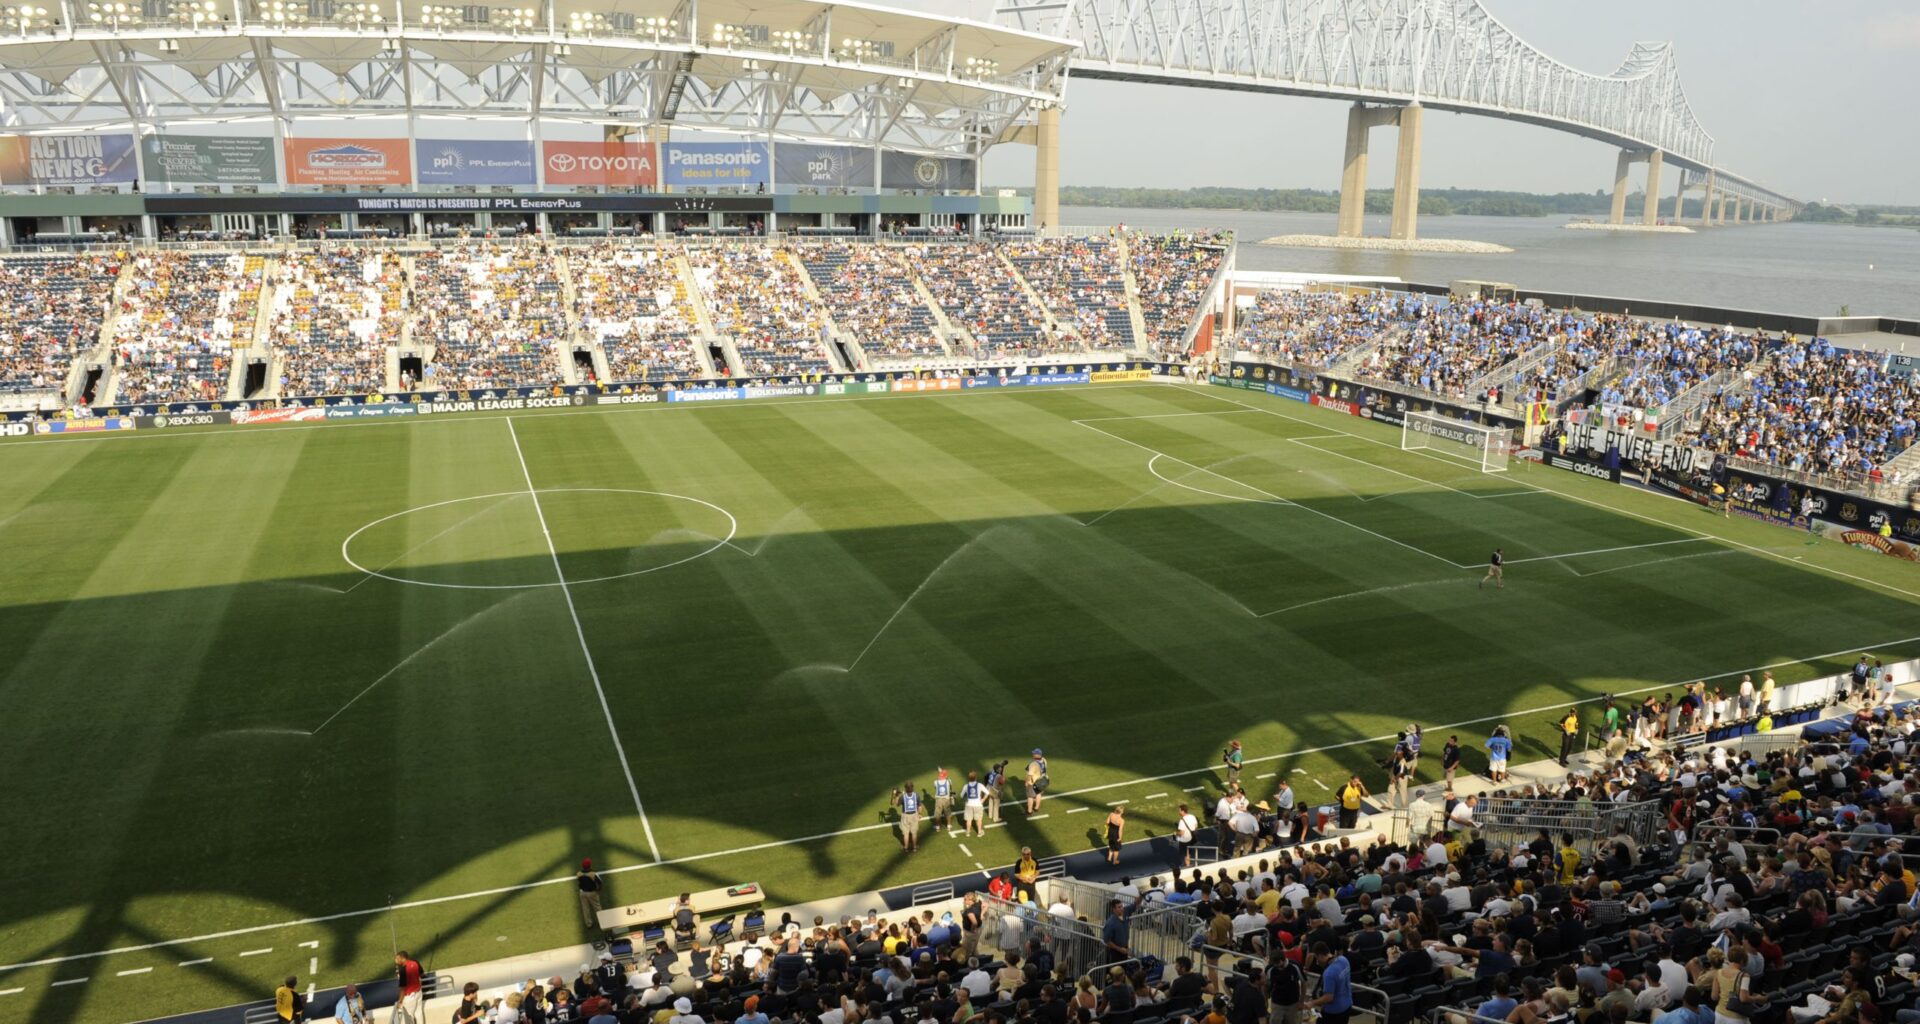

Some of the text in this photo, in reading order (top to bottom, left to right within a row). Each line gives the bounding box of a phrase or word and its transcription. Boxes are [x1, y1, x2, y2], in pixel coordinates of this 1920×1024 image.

[30, 135, 103, 158] ACTION
[162, 141, 197, 151] Premier
[311, 154, 382, 163] HORIZON
[433, 155, 453, 168] ppl
[578, 156, 651, 171] TOYOTA
[669, 149, 761, 165] Panasonic
[31, 158, 86, 178] NEWS
[682, 167, 751, 177] ideas for life
[808, 158, 828, 173] ppl
[812, 172, 832, 181] park
[358, 198, 400, 208] TONIGHT'S
[400, 198, 427, 208] MATCH
[428, 199, 437, 208] IS
[437, 198, 480, 208] PRESENTED
[481, 199, 491, 208] BY
[495, 199, 518, 208] PPL
[1897, 356, 1911, 366] 138
[1091, 372, 1129, 382] Continental
[621, 392, 658, 404] adidas
[675, 388, 739, 402] Panasonic
[750, 387, 804, 397] VOLKSWAGEN
[433, 397, 571, 412] MAJOR LEAGUE SOCCER
[1317, 395, 1352, 415] makita
[167, 415, 214, 426] XBOX 360
[237, 407, 297, 424] Budweiser
[0, 423, 29, 437] HD
[1413, 421, 1474, 445] G GATORADE G
[1572, 422, 1598, 450] THE
[1660, 444, 1694, 472] END
[1573, 462, 1611, 480] adidas
[1869, 515, 1884, 524] ppl
[1843, 531, 1875, 545] TURKEY
[1874, 536, 1894, 554] HILL
[607, 966, 616, 977] 13
